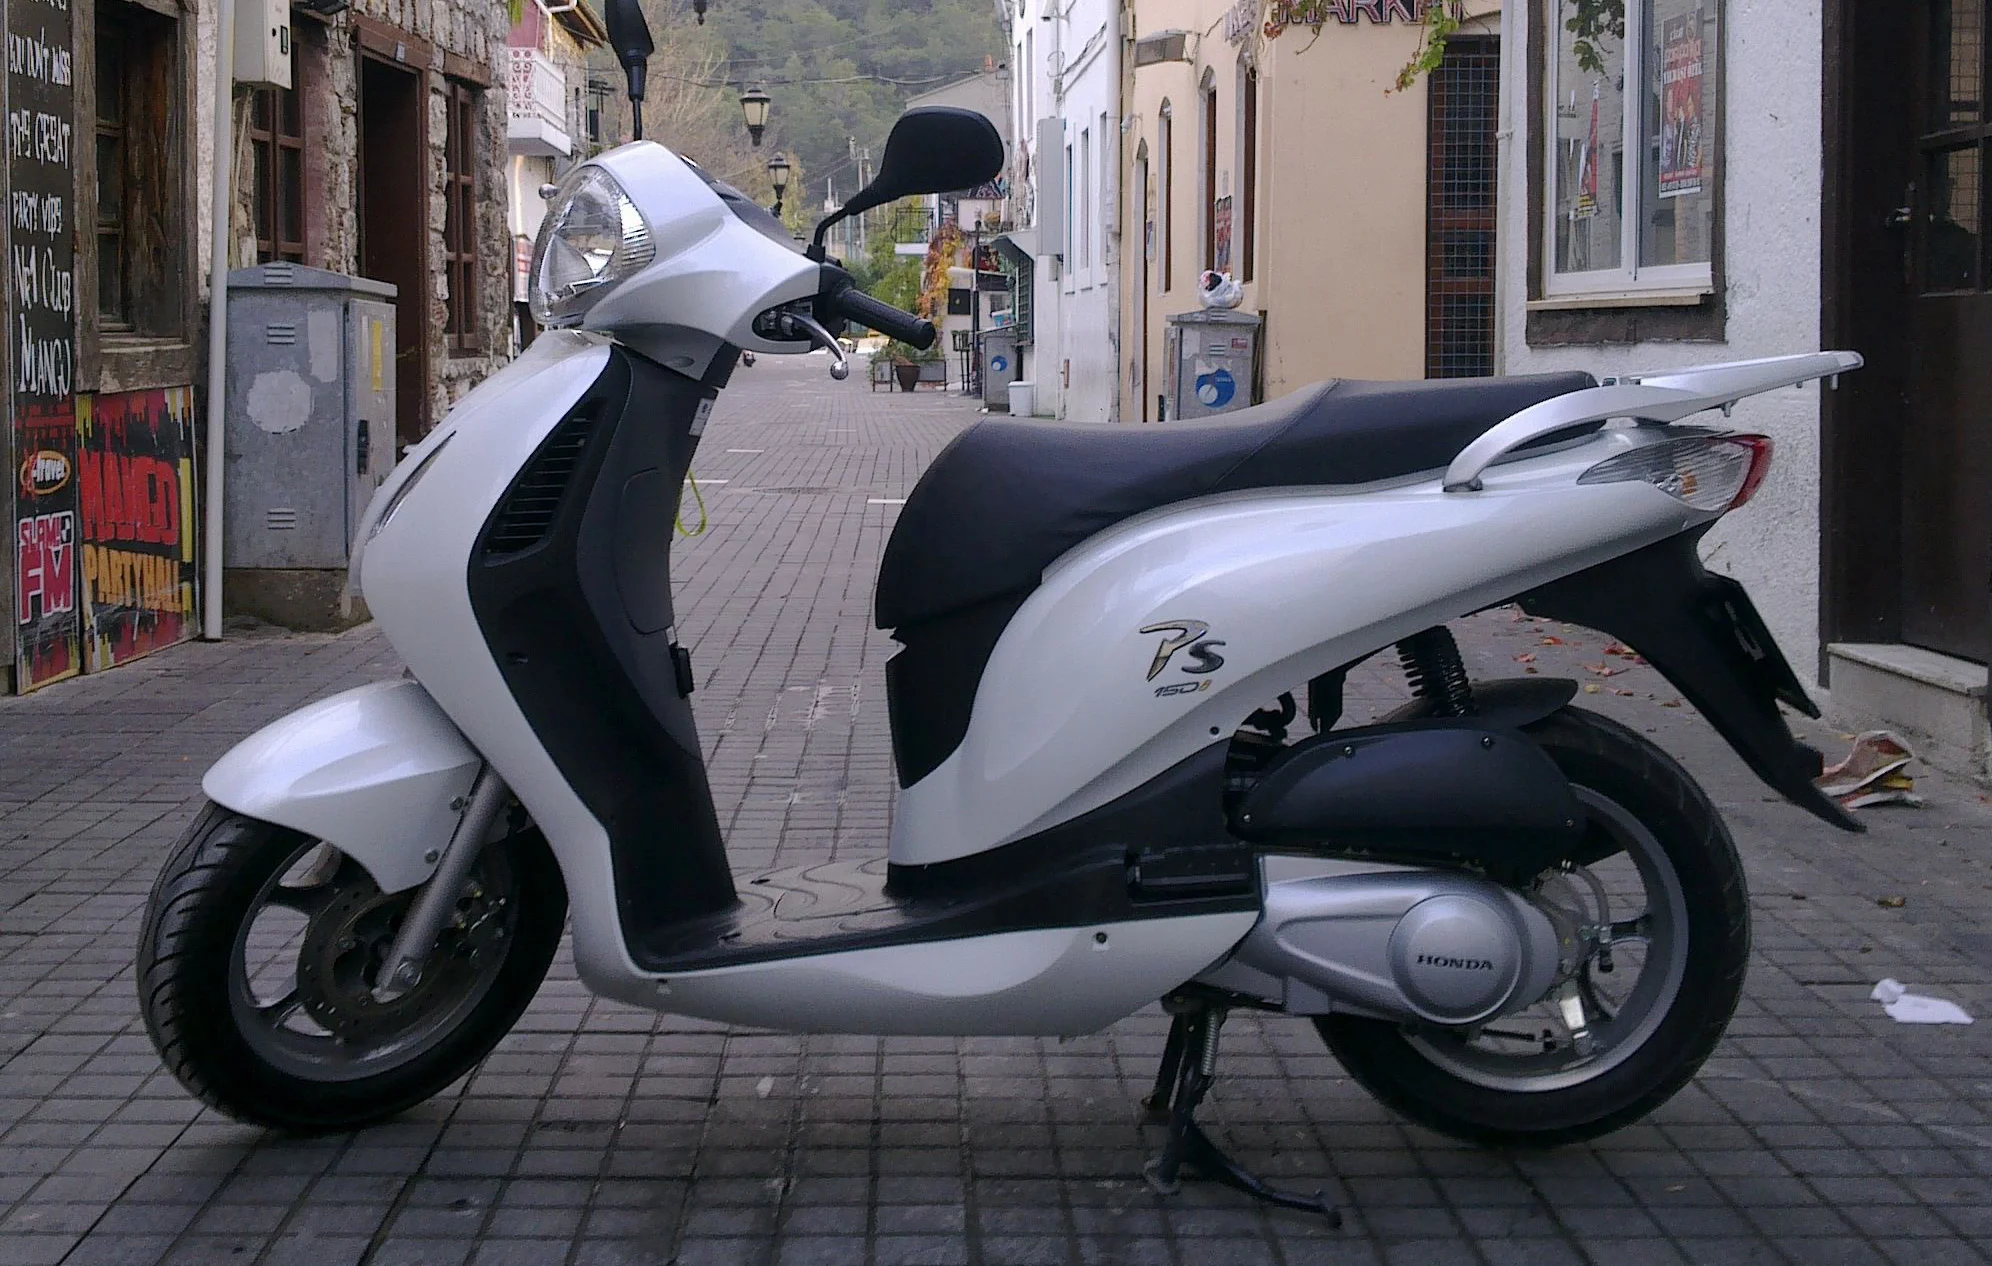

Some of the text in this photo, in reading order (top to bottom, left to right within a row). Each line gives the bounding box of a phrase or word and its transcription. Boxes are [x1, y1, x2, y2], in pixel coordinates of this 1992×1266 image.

[10, 108, 70, 170] THE GREAT
[12, 190, 62, 241] PARTY VIBE
[78, 447, 178, 546] MANGO
[19, 544, 73, 625] FM
[1139, 619, 1226, 682] PS
[1416, 954, 1494, 971] HONDA
